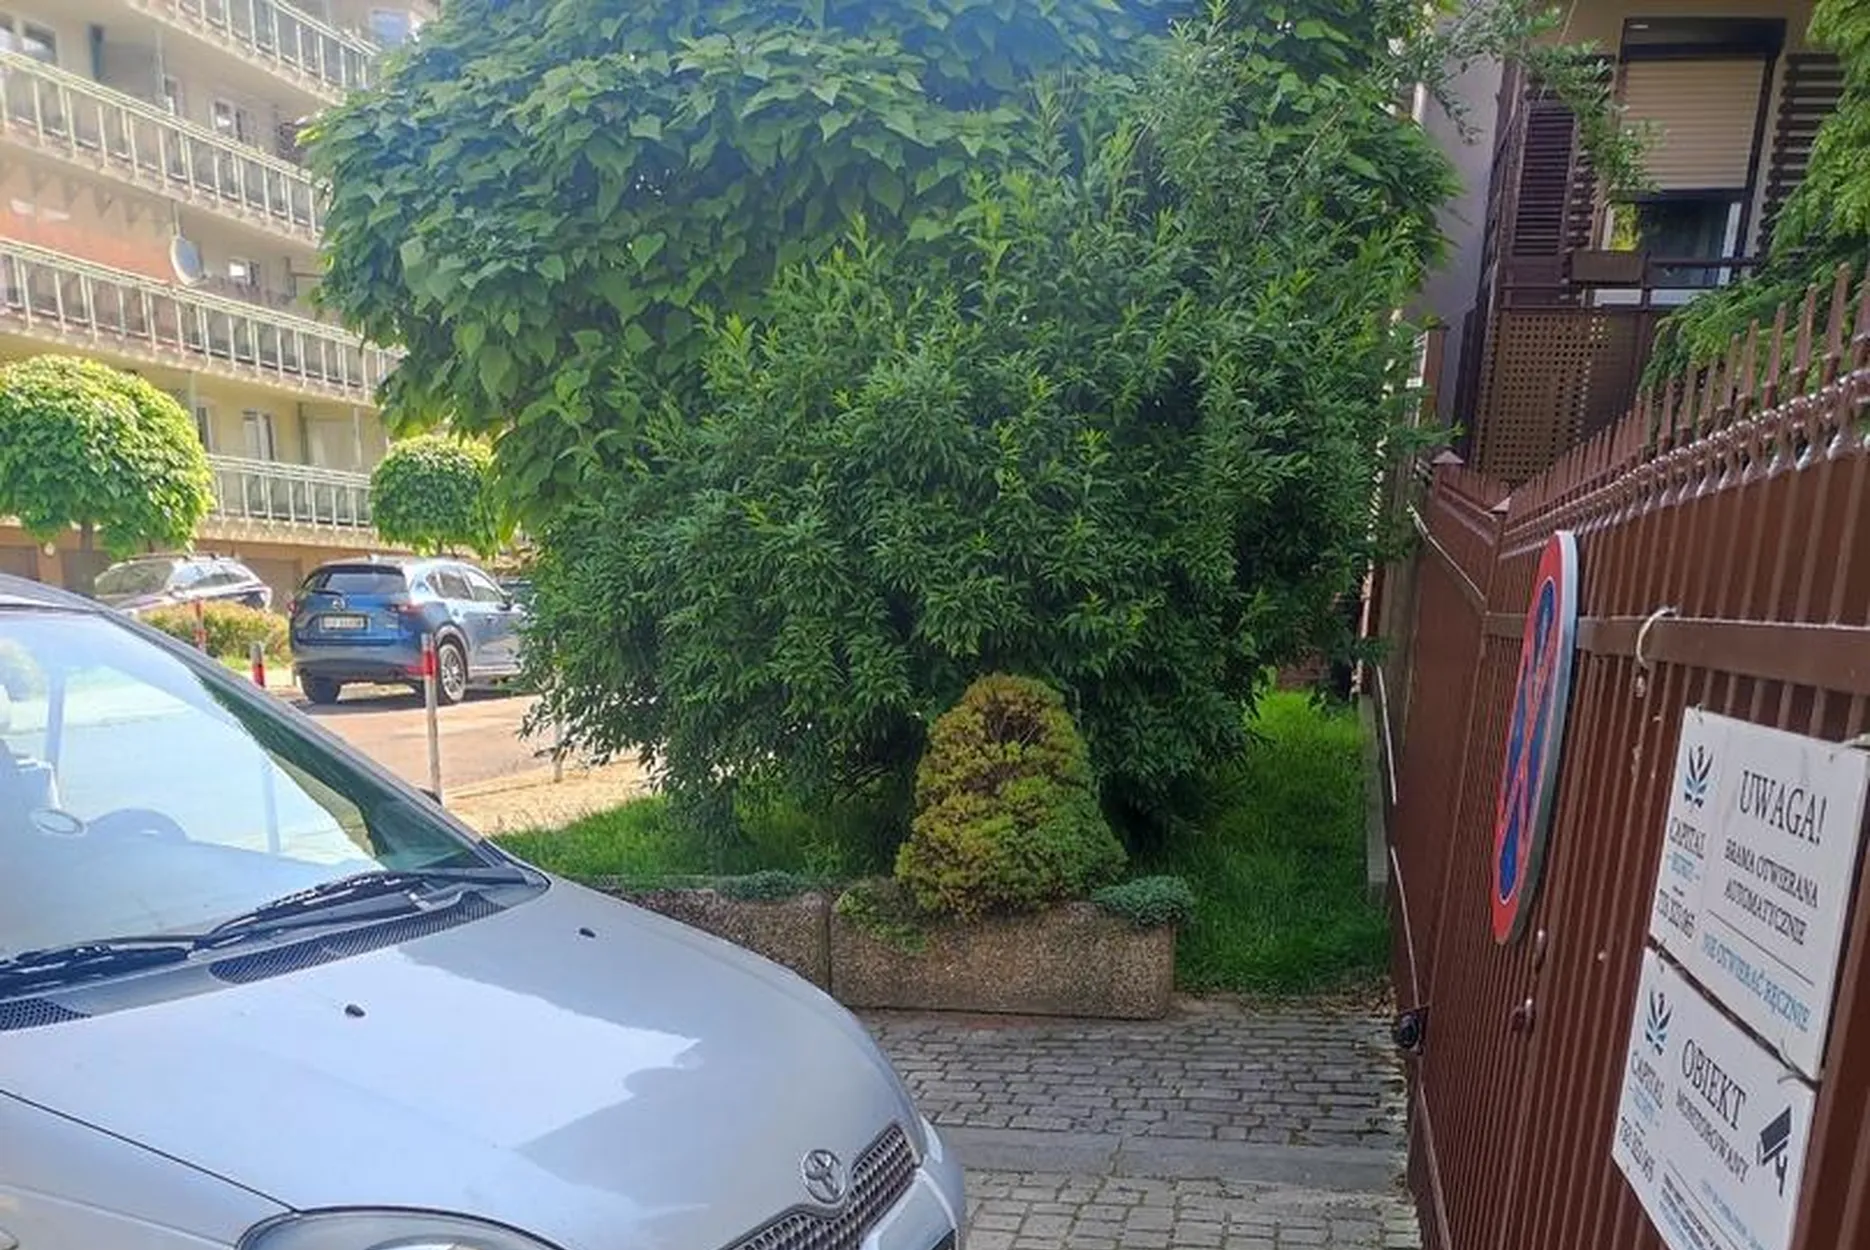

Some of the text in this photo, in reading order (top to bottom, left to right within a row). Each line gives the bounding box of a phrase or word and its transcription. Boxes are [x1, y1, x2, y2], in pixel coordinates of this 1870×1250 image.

[1740, 770, 1826, 845] UWAGA!
[1724, 838, 1755, 873] BRAMA
[1755, 855, 1818, 908] OTWIERANA
[1681, 1038, 1746, 1131] OBIEKT
